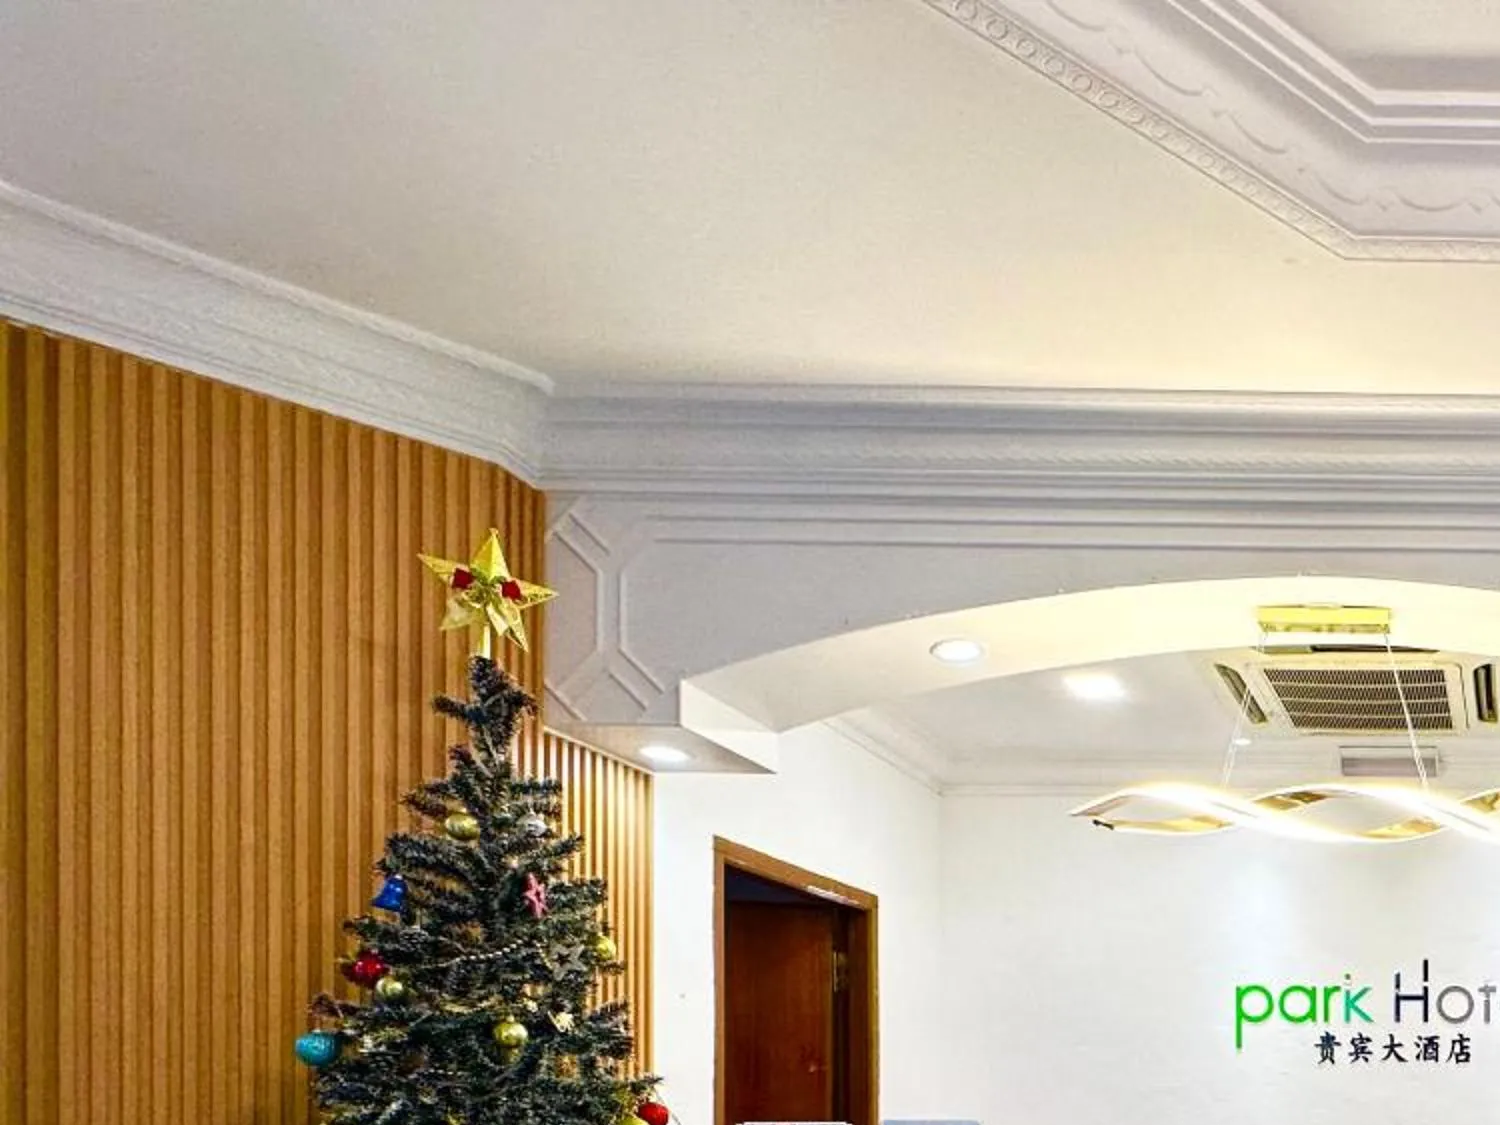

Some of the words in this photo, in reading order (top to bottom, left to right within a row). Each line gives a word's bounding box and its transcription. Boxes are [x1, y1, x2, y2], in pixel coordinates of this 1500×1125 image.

[1235, 973, 1374, 1050] park
[1313, 1030, 1473, 1065] 贵宾大酒店
